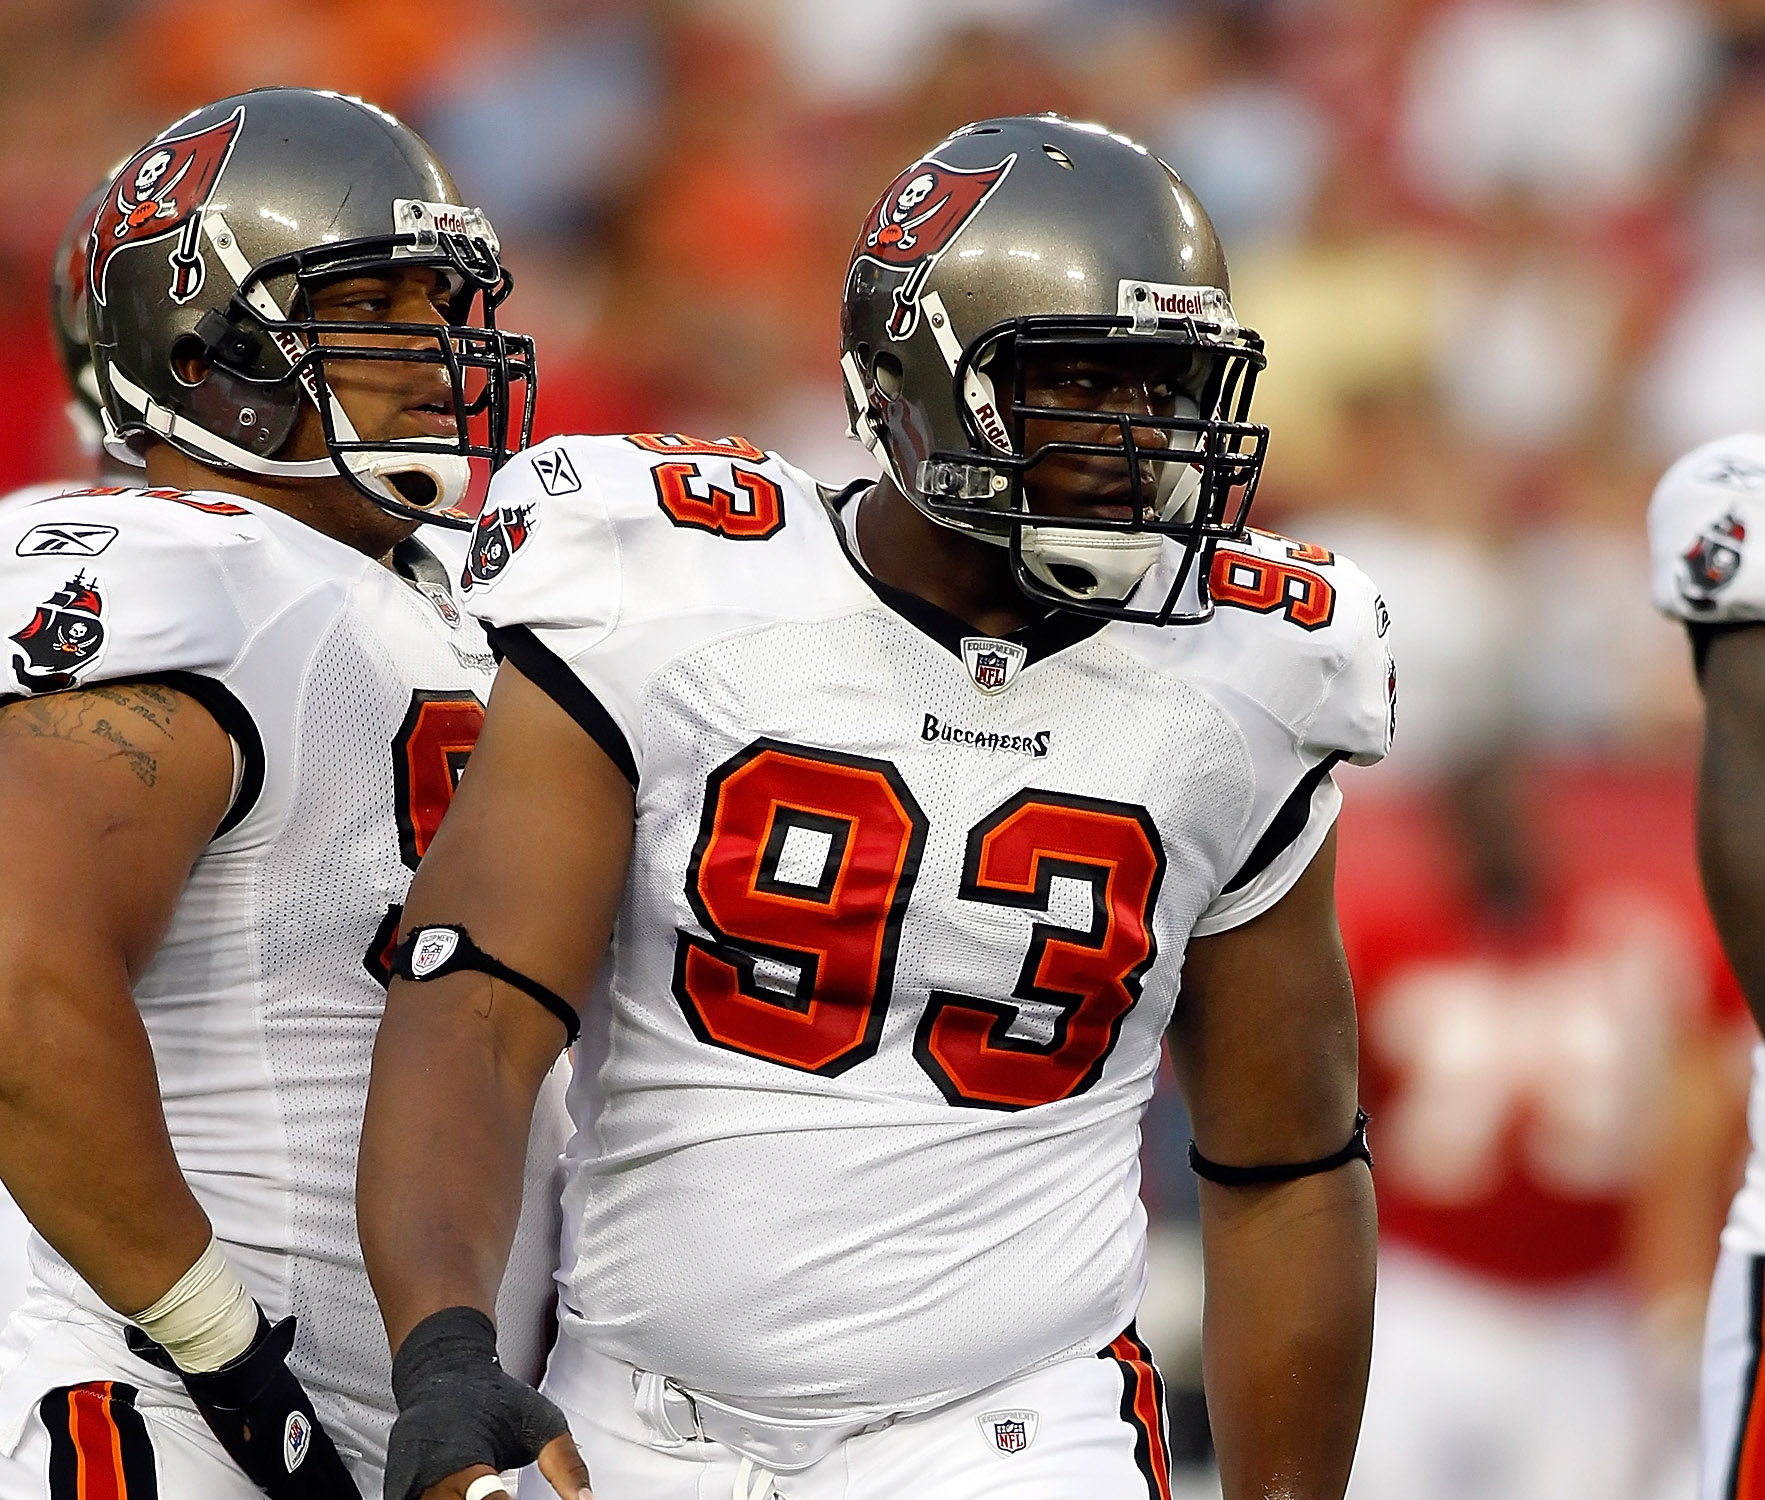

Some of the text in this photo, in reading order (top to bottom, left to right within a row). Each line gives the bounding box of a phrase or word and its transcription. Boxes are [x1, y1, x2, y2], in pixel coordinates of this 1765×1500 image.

[967, 642, 1021, 660] EQUIPMENT
[978, 666, 1004, 686] NFL
[671, 736, 1168, 1113] 93
[998, 1433, 1024, 1450] NFL
